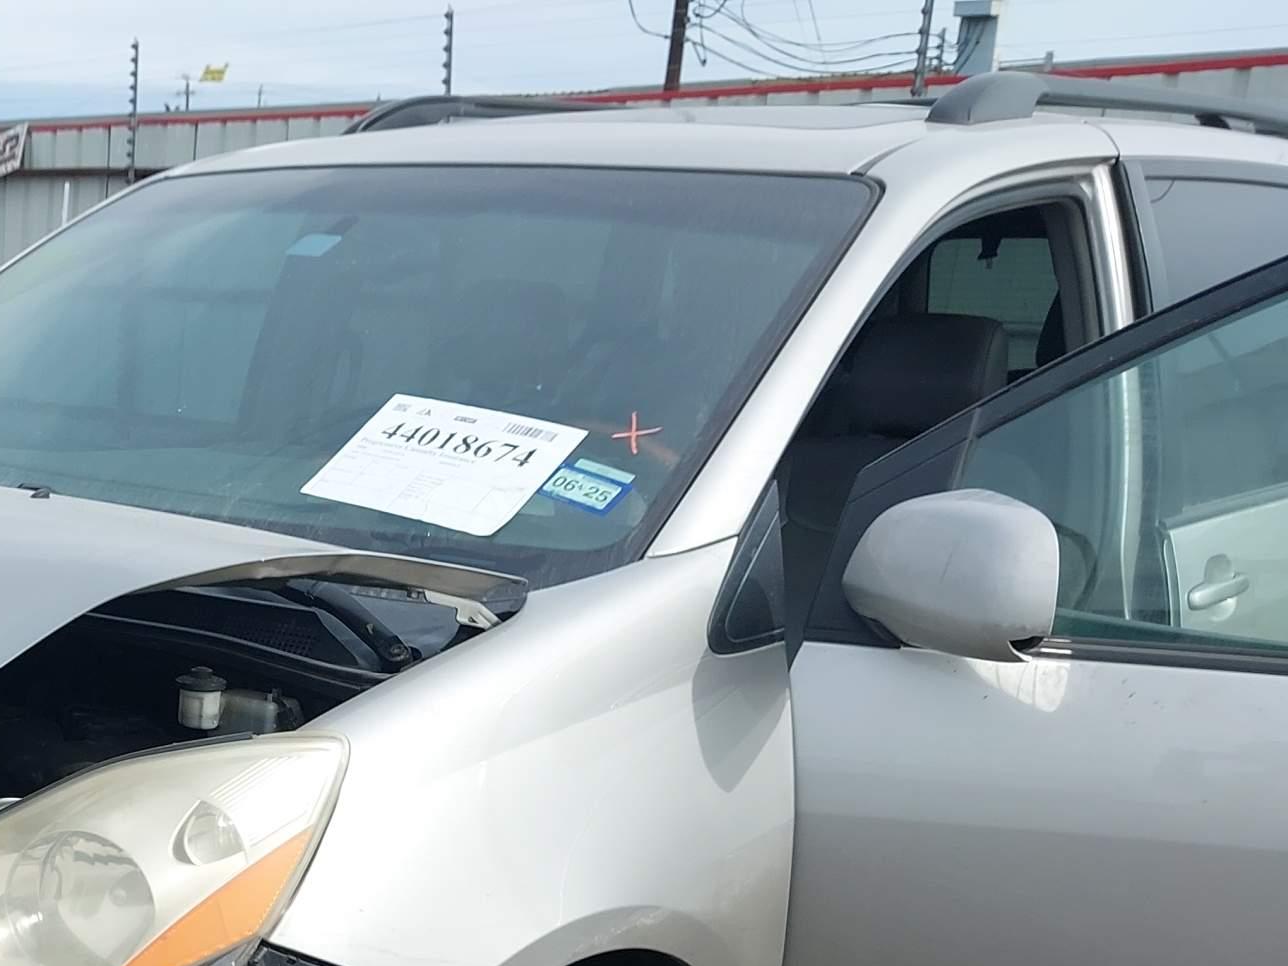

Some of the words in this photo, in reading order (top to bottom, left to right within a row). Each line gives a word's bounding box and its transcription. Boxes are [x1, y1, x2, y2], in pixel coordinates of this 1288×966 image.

[381, 422, 538, 467] 44018674
[552, 475, 580, 492] 06
[583, 486, 612, 502] 25
